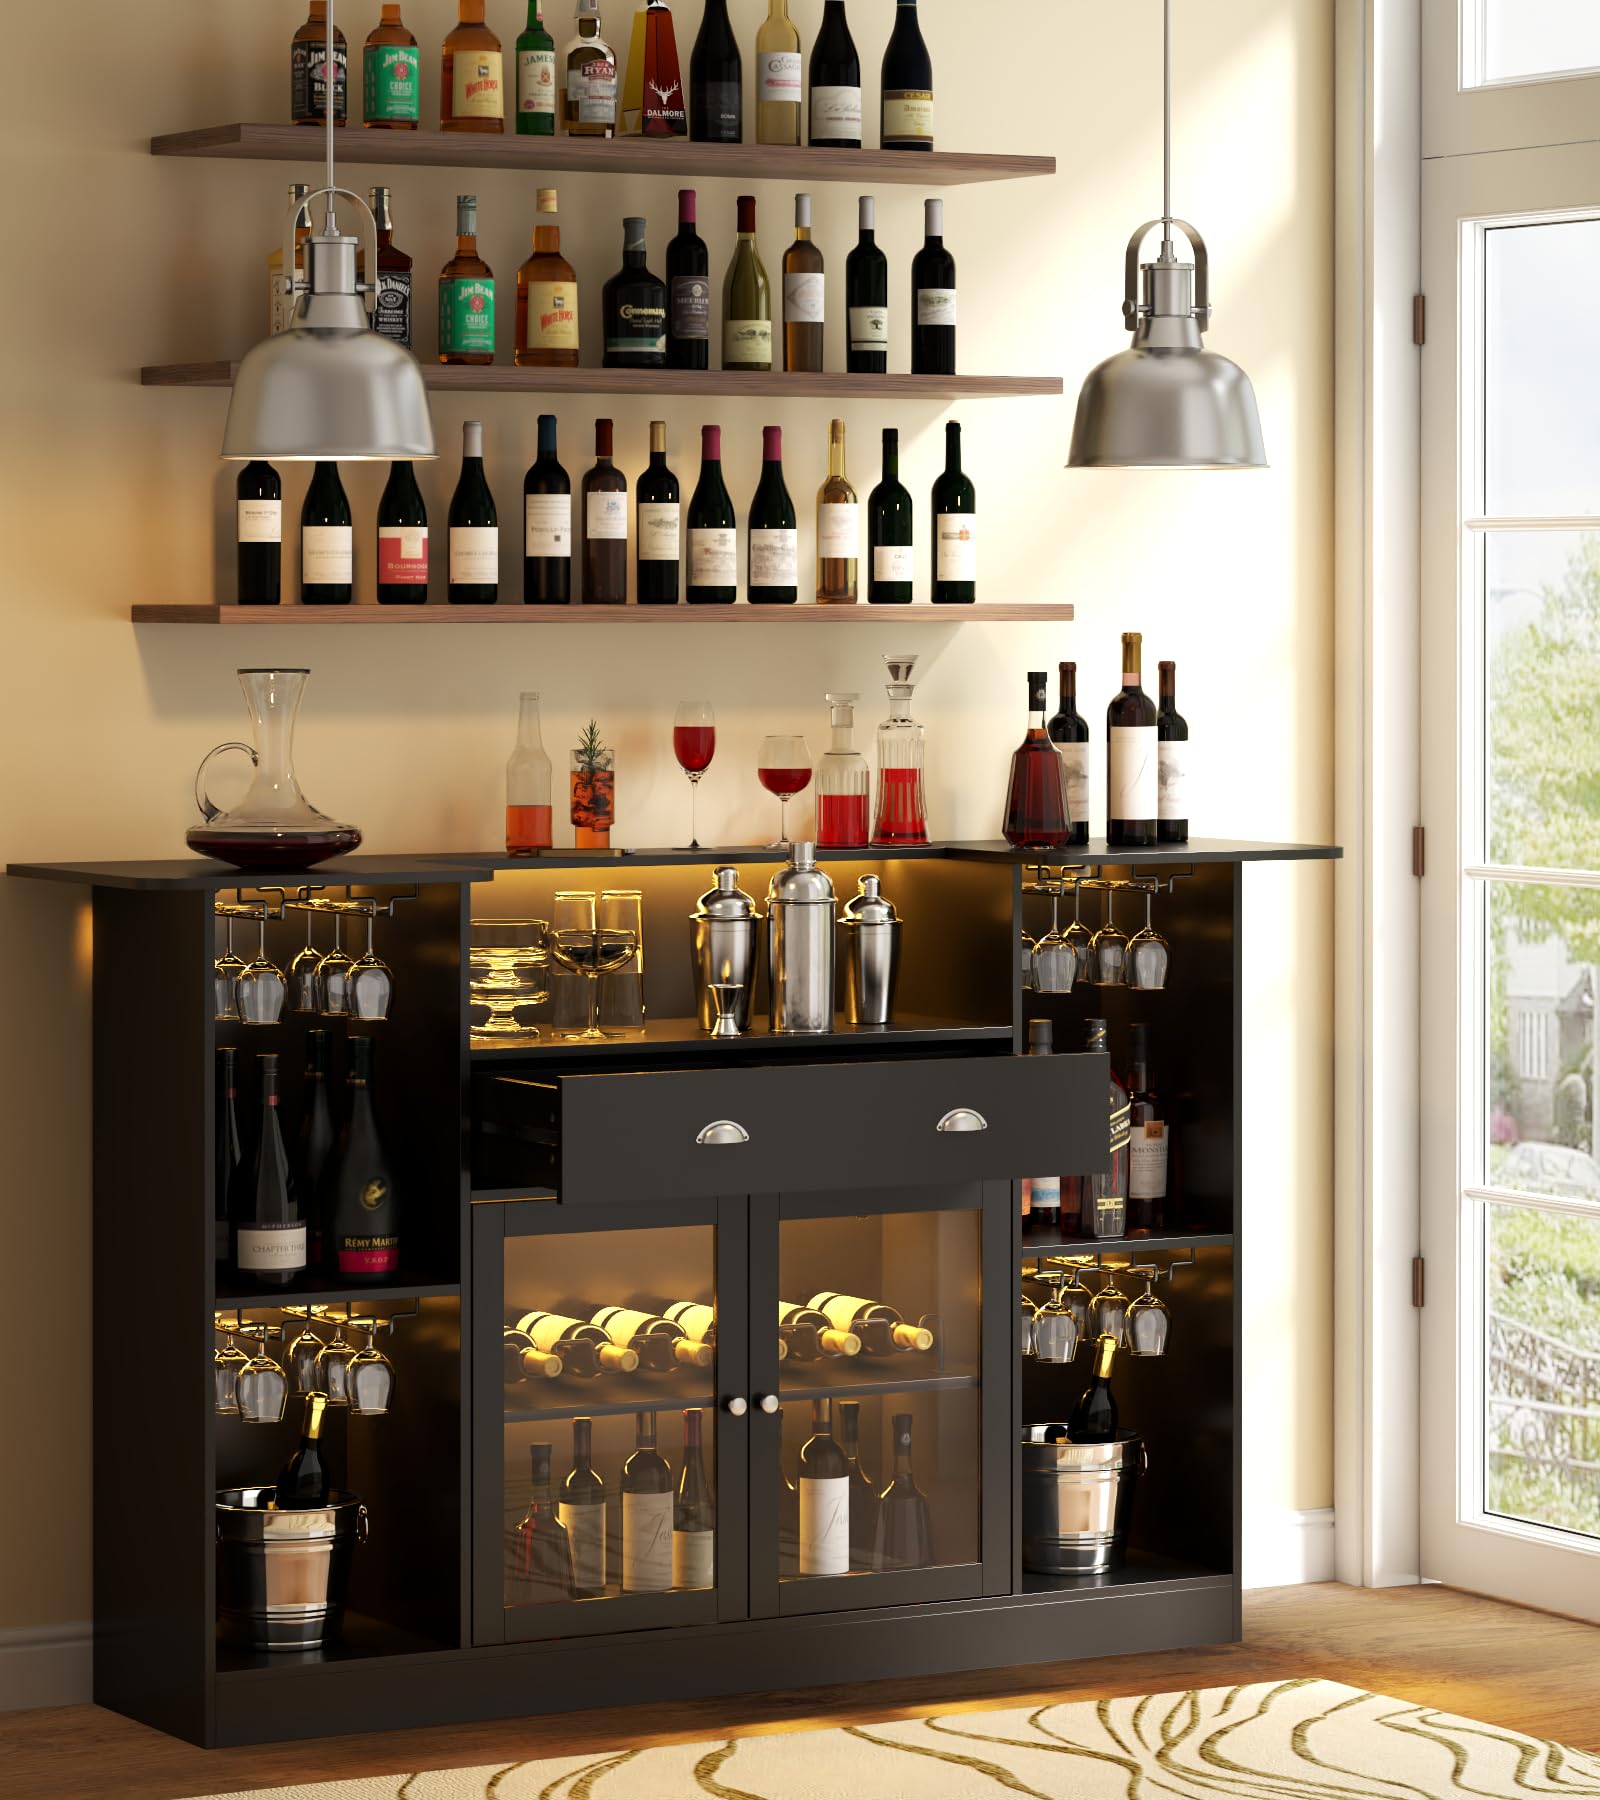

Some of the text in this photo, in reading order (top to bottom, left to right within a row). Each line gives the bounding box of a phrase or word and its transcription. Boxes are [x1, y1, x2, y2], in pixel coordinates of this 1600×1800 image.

[307, 50, 347, 68] JIM EAM
[383, 52, 398, 68] JIM
[584, 66, 614, 76] RYAN
[314, 82, 344, 92] BLCK
[647, 109, 685, 118] DALMORE
[458, 286, 474, 300] JIM
